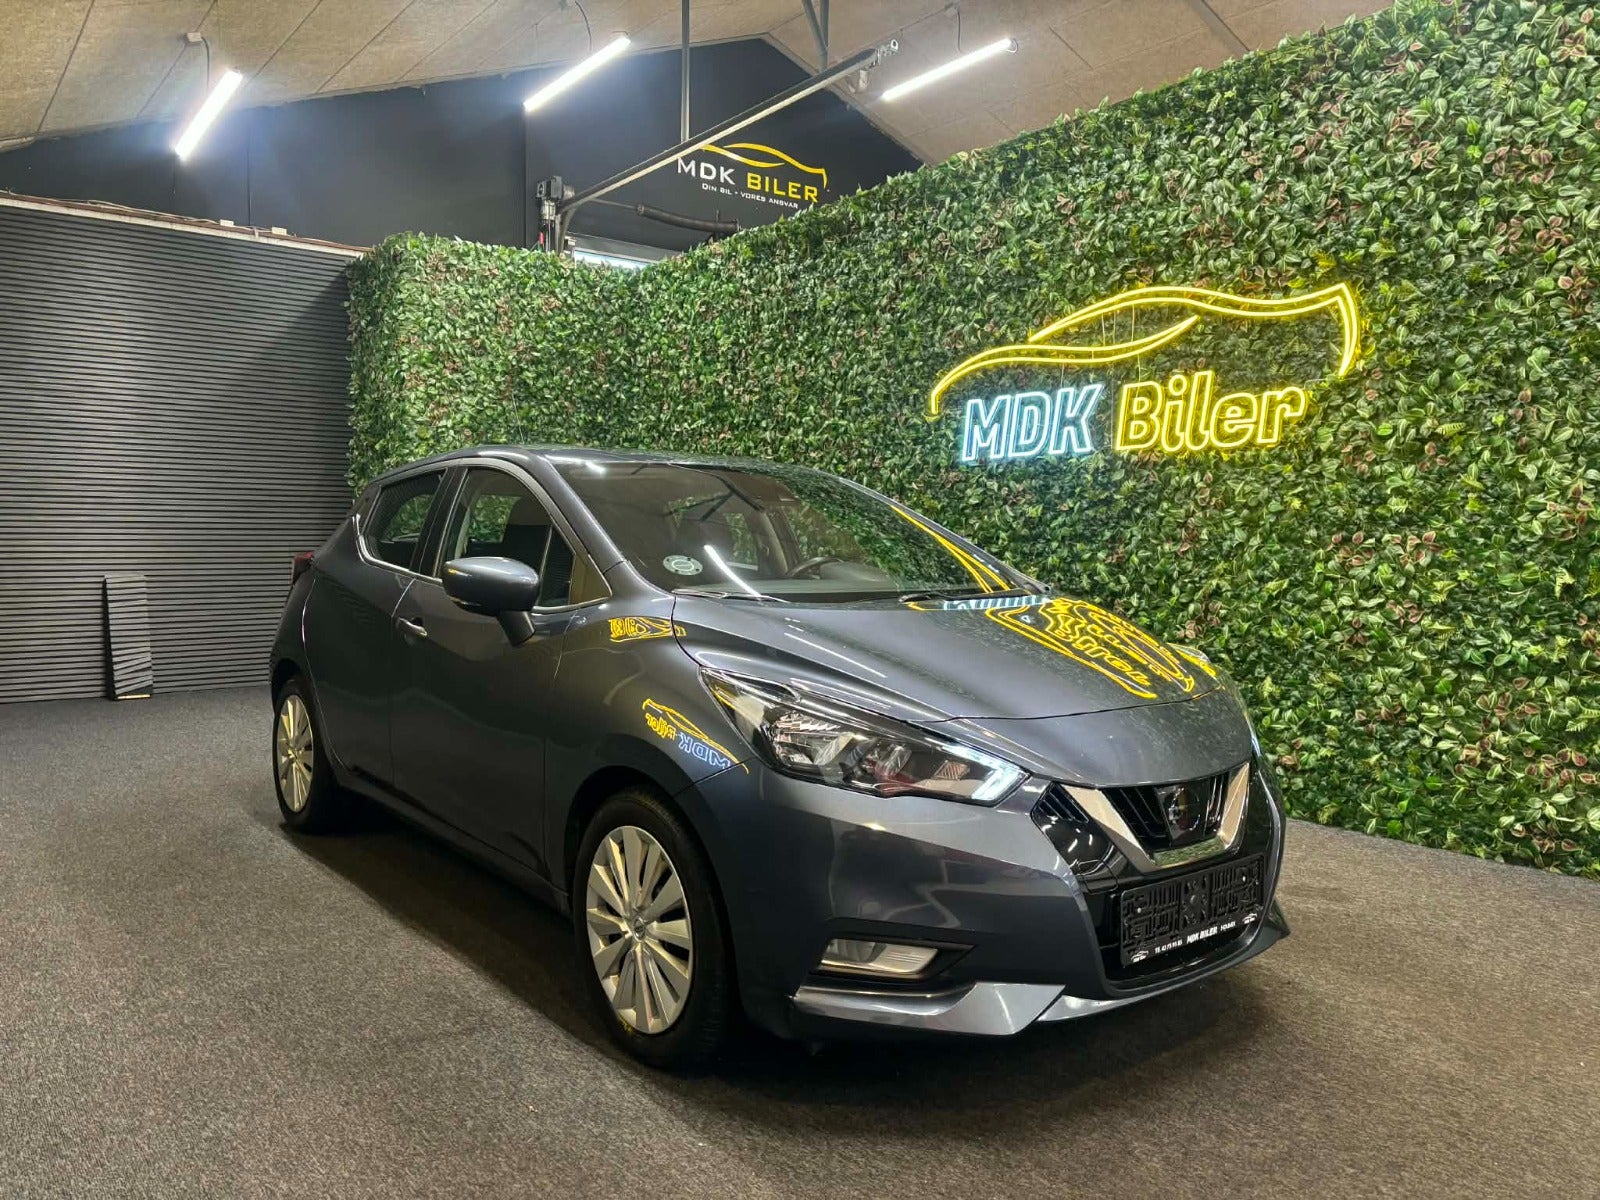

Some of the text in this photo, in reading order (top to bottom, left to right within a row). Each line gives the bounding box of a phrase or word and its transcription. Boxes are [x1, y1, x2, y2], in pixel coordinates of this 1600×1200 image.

[677, 157, 818, 203] MDK BILER
[768, 198, 799, 209] ANSVAR
[960, 369, 1308, 463] MDK Biler
